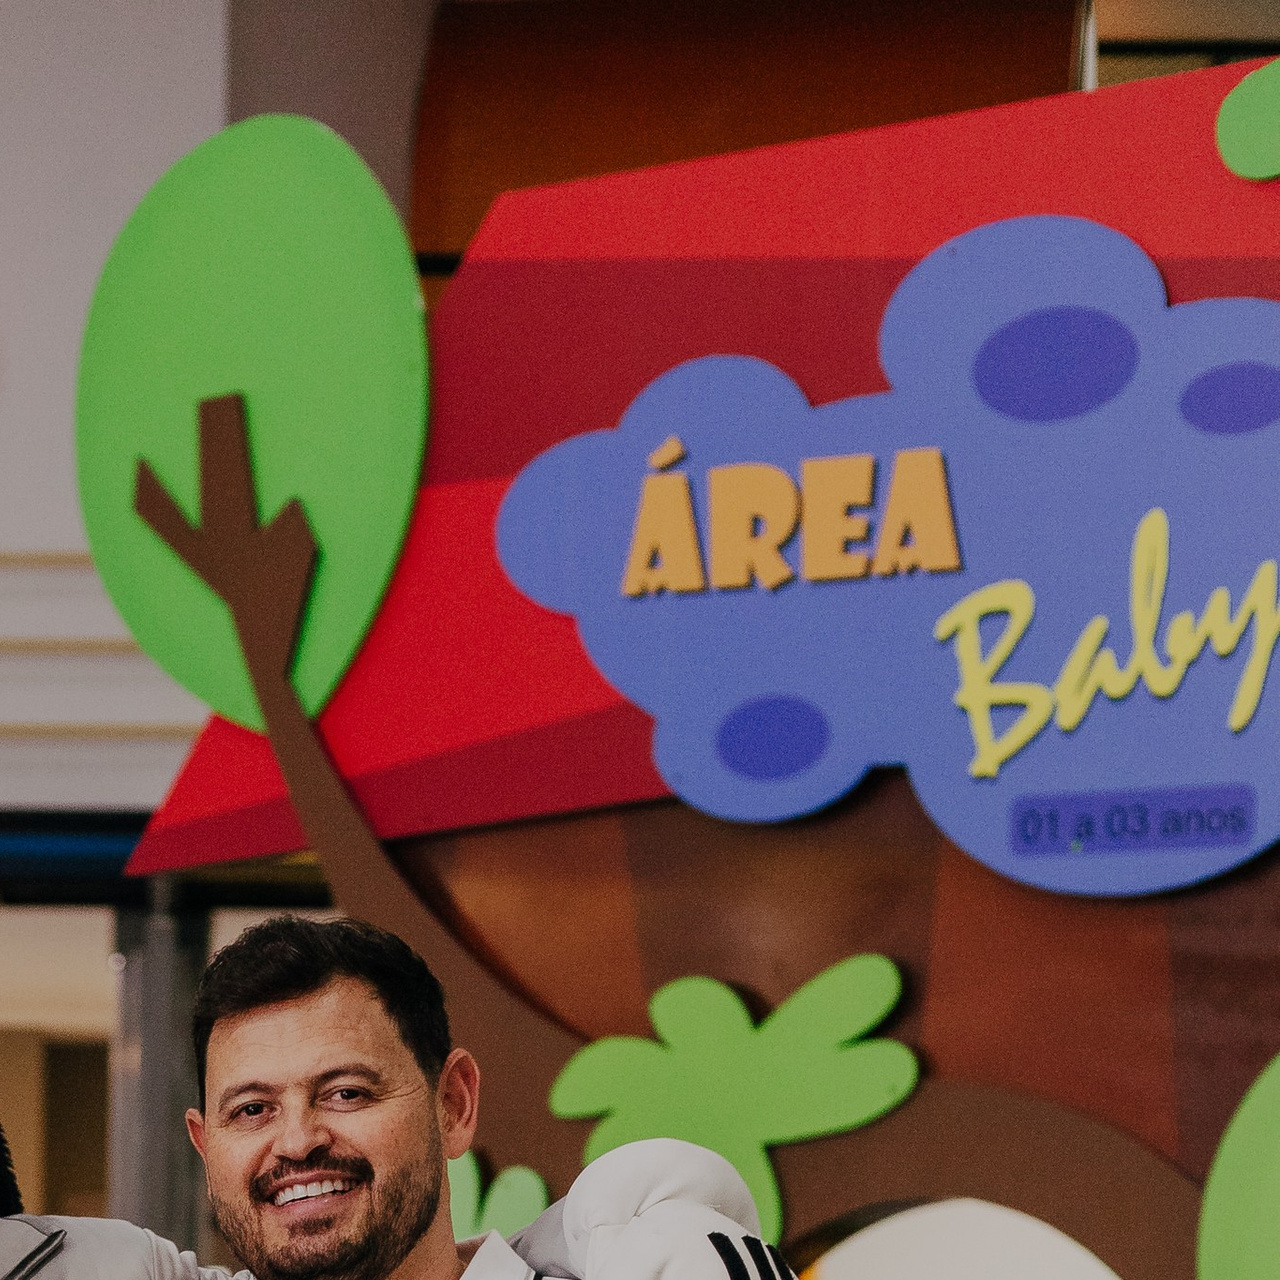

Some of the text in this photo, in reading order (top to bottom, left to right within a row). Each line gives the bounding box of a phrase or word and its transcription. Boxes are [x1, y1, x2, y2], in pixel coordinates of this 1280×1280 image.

[622, 435, 964, 598] ÁREA
[933, 507, 1280, 778] Baby
[1021, 803, 1248, 846] 01 a 03 anos
